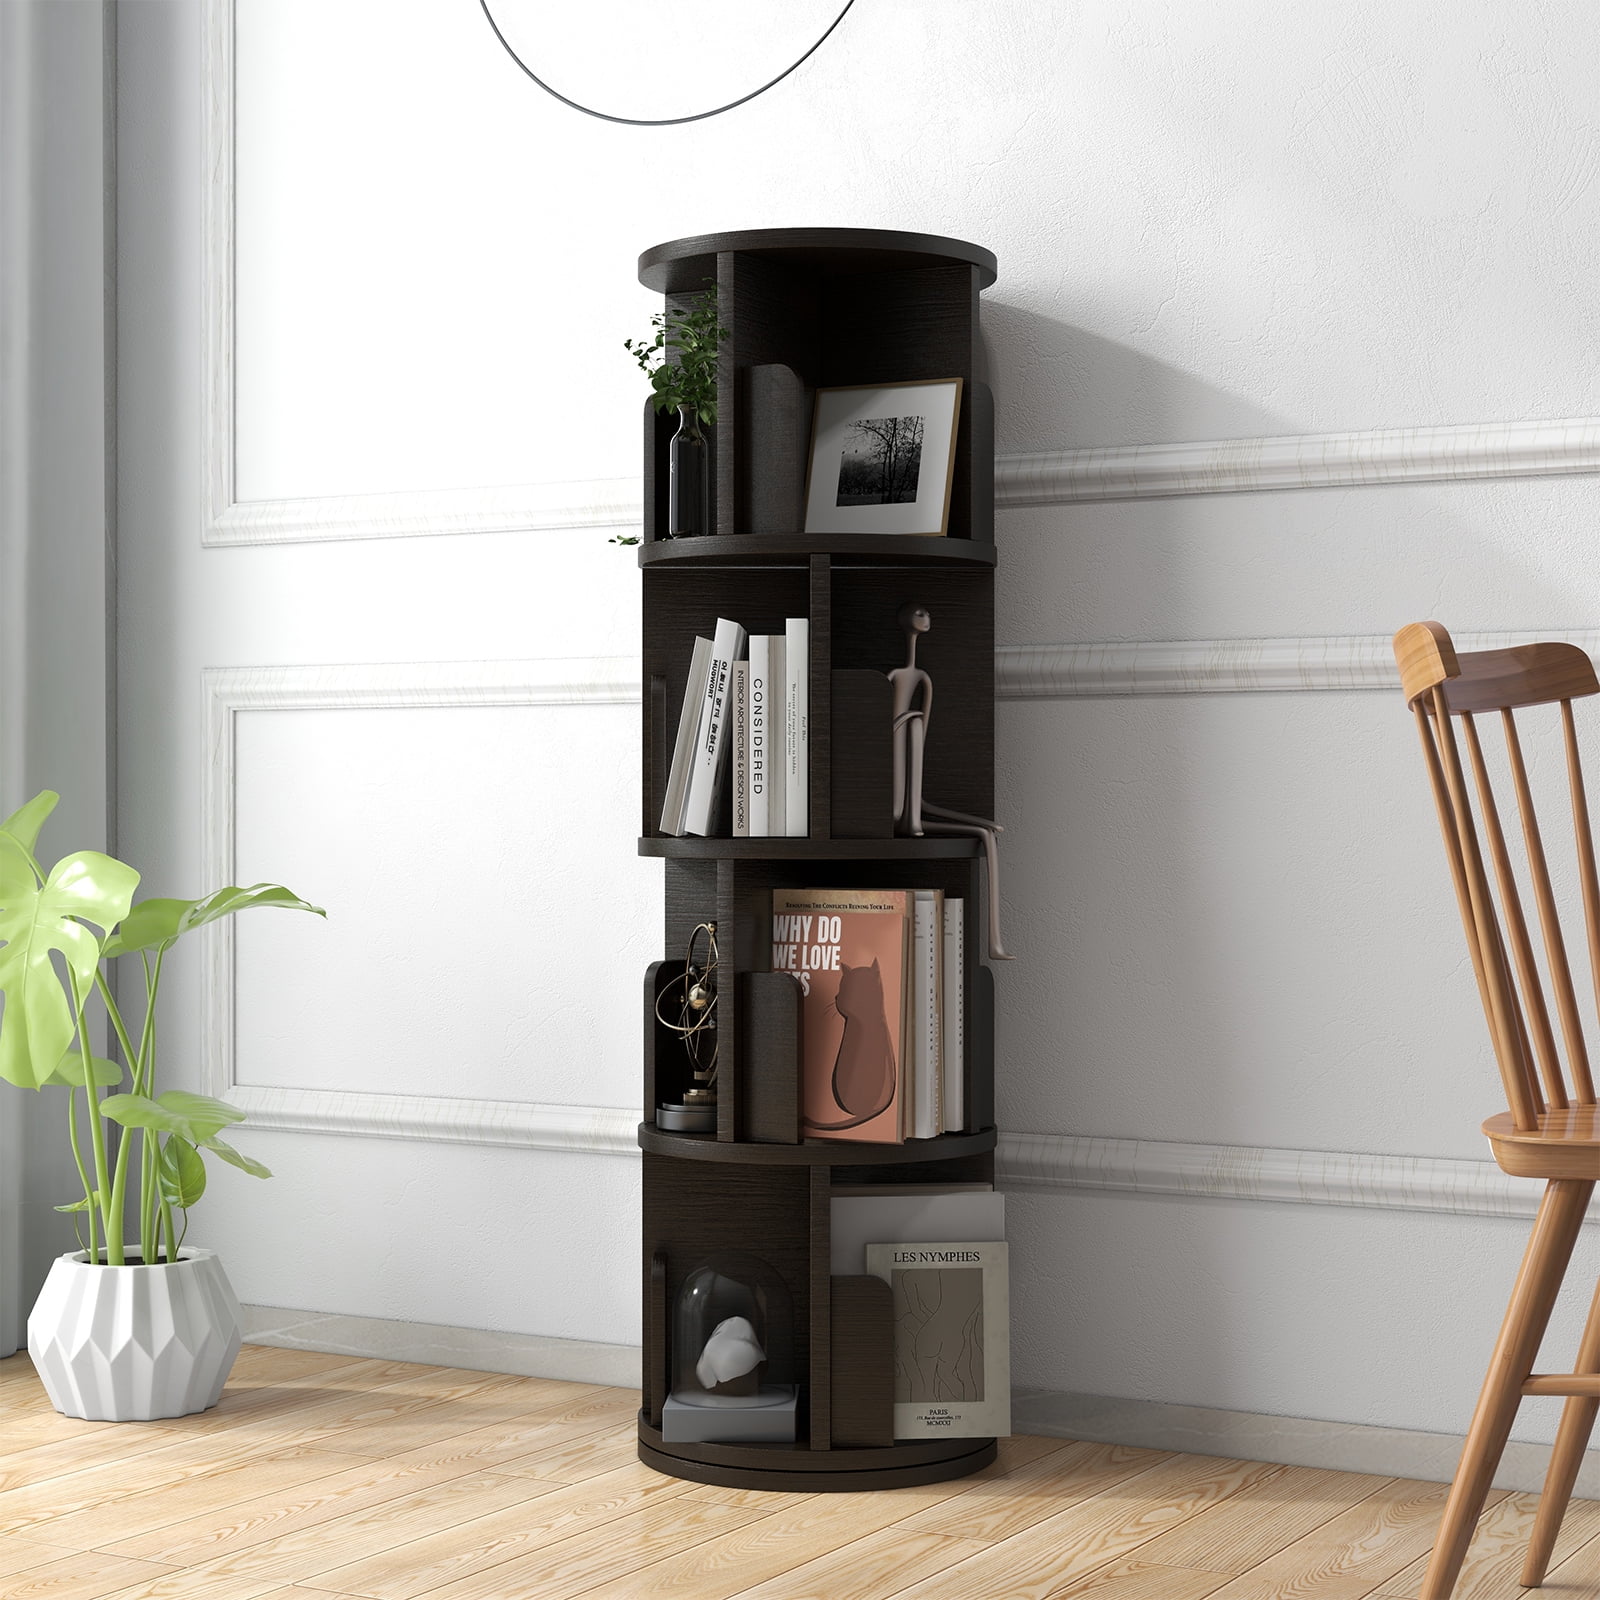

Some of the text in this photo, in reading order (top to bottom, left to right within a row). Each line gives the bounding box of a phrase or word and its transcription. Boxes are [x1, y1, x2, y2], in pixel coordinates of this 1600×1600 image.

[708, 660, 718, 699] MUGWORT
[754, 678, 762, 794] CONSIDERED
[773, 914, 842, 944] WHY DO
[773, 944, 840, 970] WE LOVE
[894, 1251, 980, 1262] LES NYMPHES
